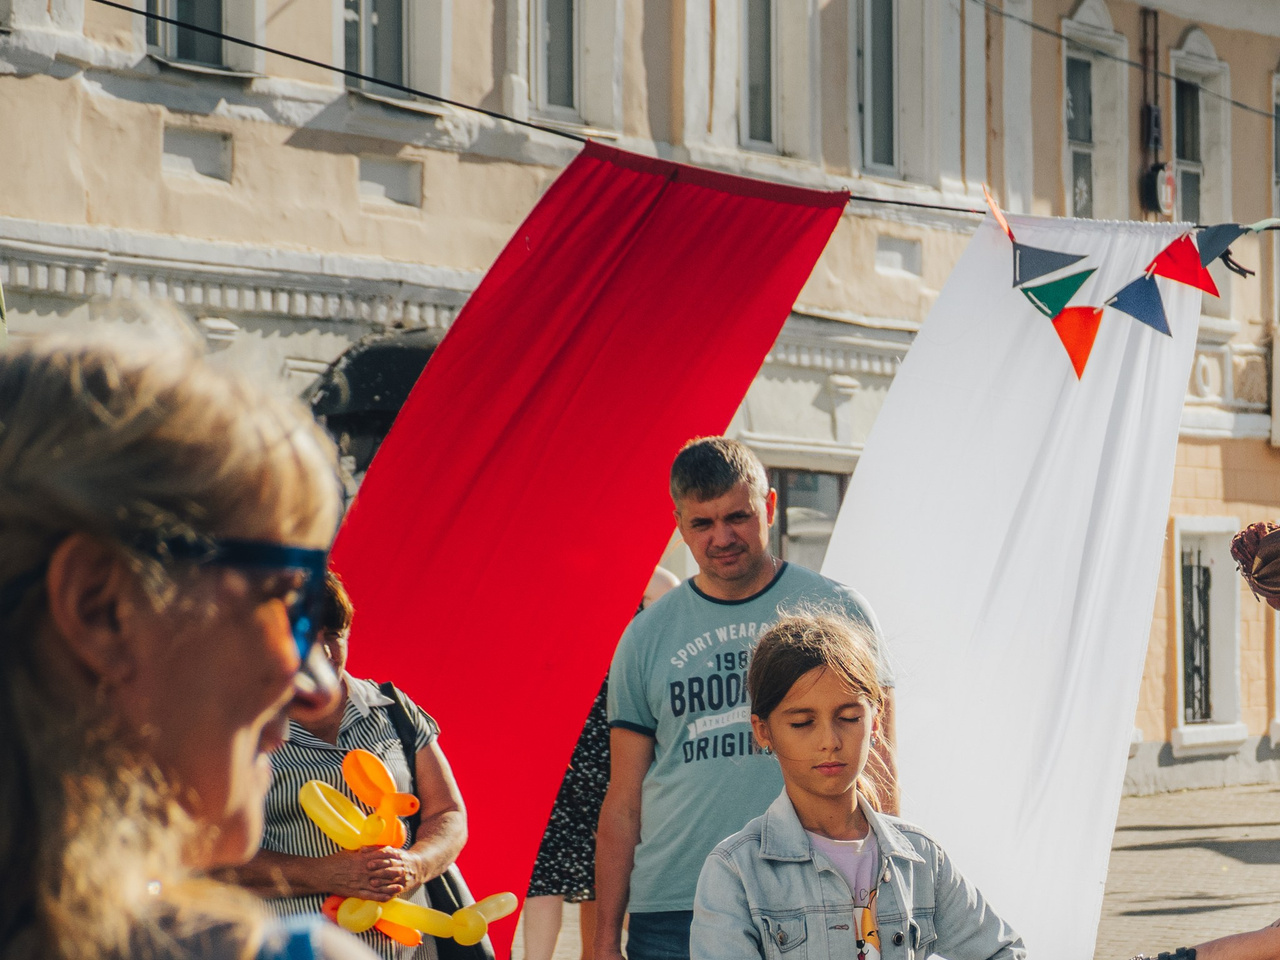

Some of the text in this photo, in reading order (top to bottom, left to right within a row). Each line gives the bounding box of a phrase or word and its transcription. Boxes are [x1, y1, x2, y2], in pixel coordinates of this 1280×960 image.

[670, 632, 713, 668] SPORT
[715, 622, 757, 642] WEAR
[715, 651, 749, 671] 198
